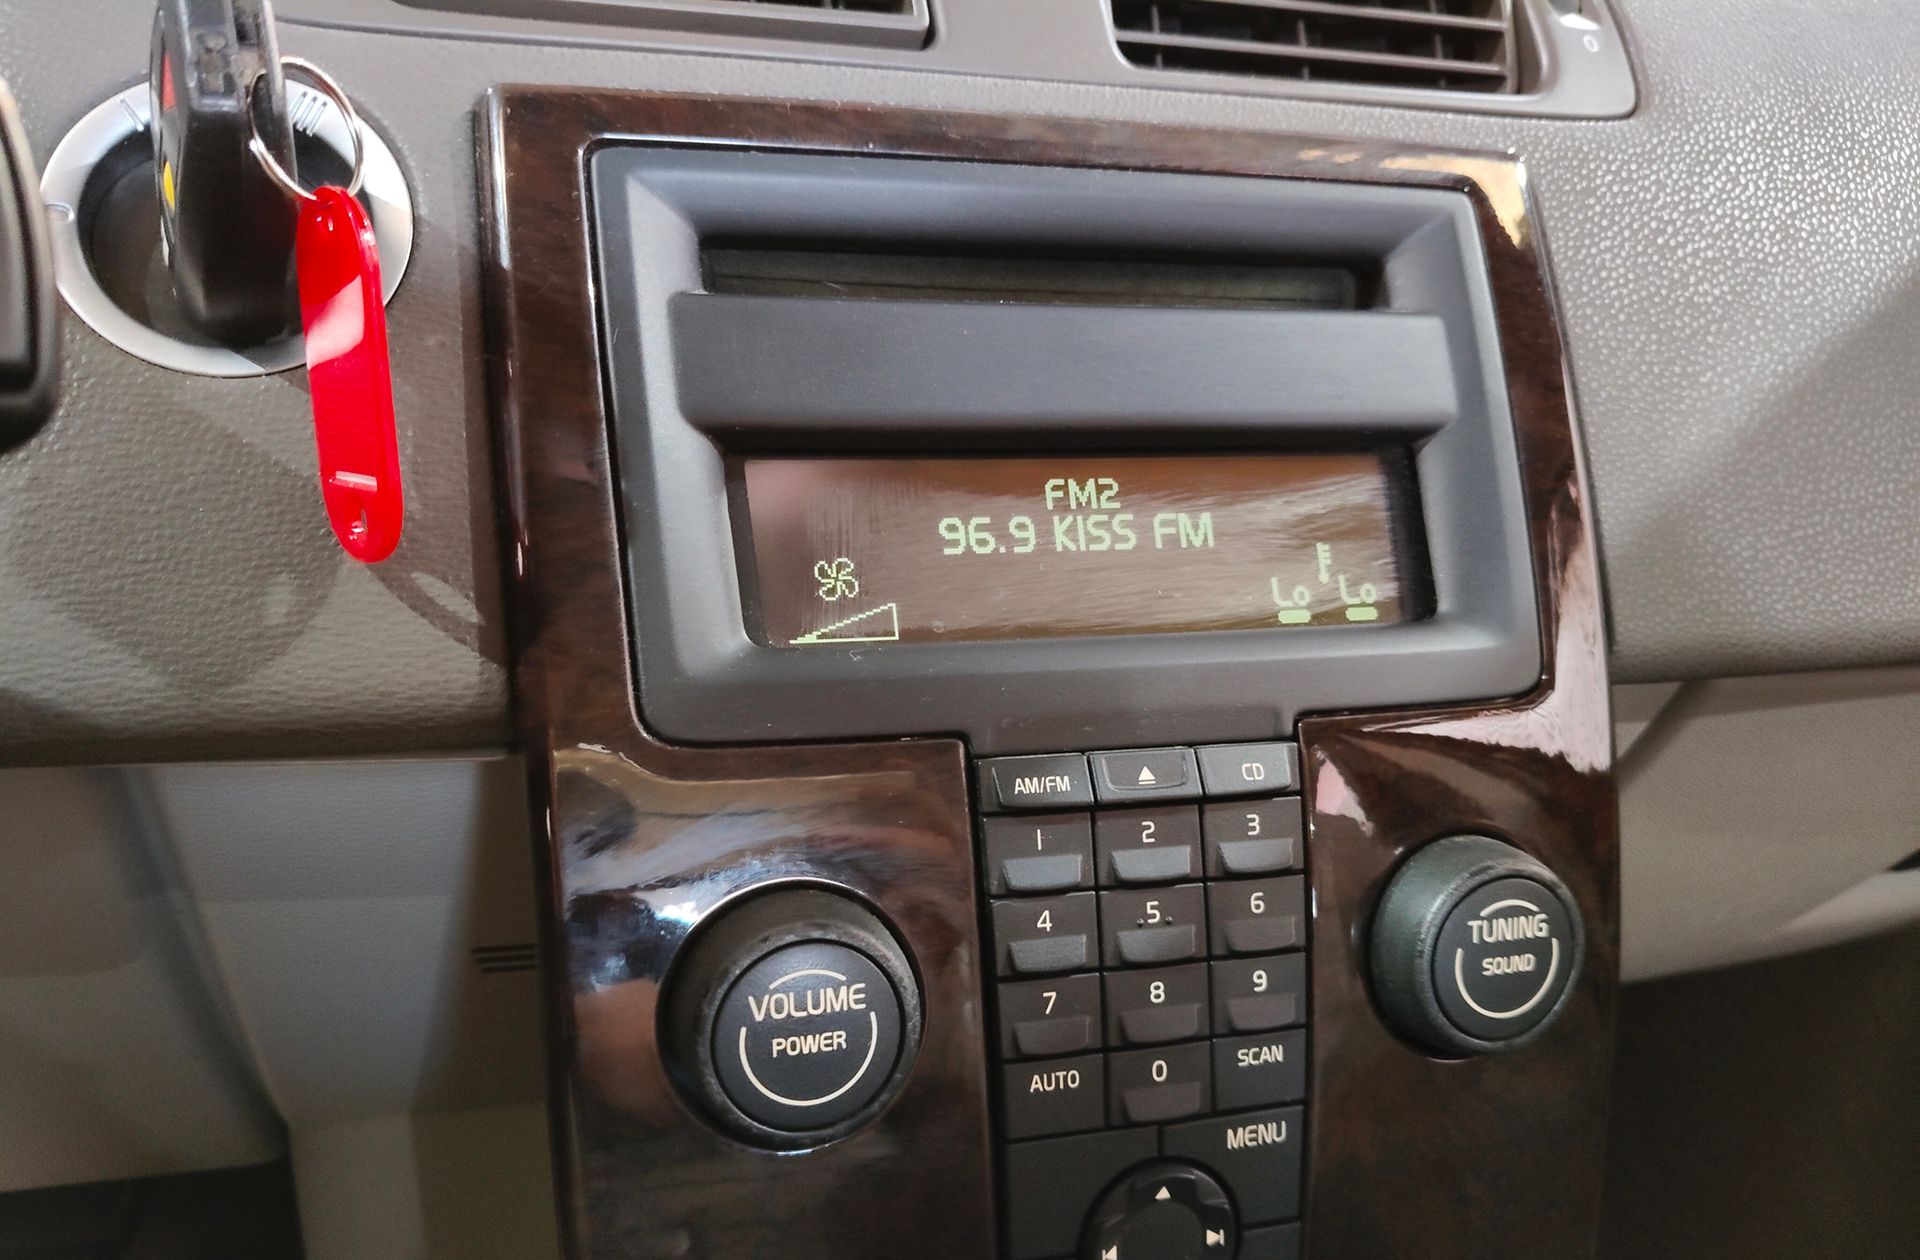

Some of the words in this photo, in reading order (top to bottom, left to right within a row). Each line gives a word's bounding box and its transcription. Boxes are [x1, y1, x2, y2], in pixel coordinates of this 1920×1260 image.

[1044, 477, 1122, 511] FM2
[938, 515, 1037, 556] 96.9
[1052, 513, 1137, 552] KISS
[1152, 511, 1215, 549] FM
[1270, 576, 1311, 608] Lo
[1337, 574, 1377, 605] Lo
[1241, 762, 1265, 781] CD
[1014, 775, 1071, 795] AM/FM
[1141, 820, 1156, 843] 2
[1246, 813, 1261, 836] 3
[1146, 900, 1161, 924] 5
[1250, 891, 1265, 914] 6
[1036, 909, 1053, 932] 4
[1466, 912, 1549, 945] TUNING
[1481, 953, 1536, 976] SOUND
[1252, 969, 1268, 992] 9
[747, 980, 867, 1022] VOLUME
[1042, 991, 1057, 1015] 7
[1149, 981, 1166, 1004] 8
[771, 1030, 847, 1058] POWER
[1237, 1044, 1284, 1067] SCAN
[1029, 1069, 1080, 1093] AUTO
[1151, 1059, 1168, 1082] 0
[1226, 1120, 1287, 1150] MENU
